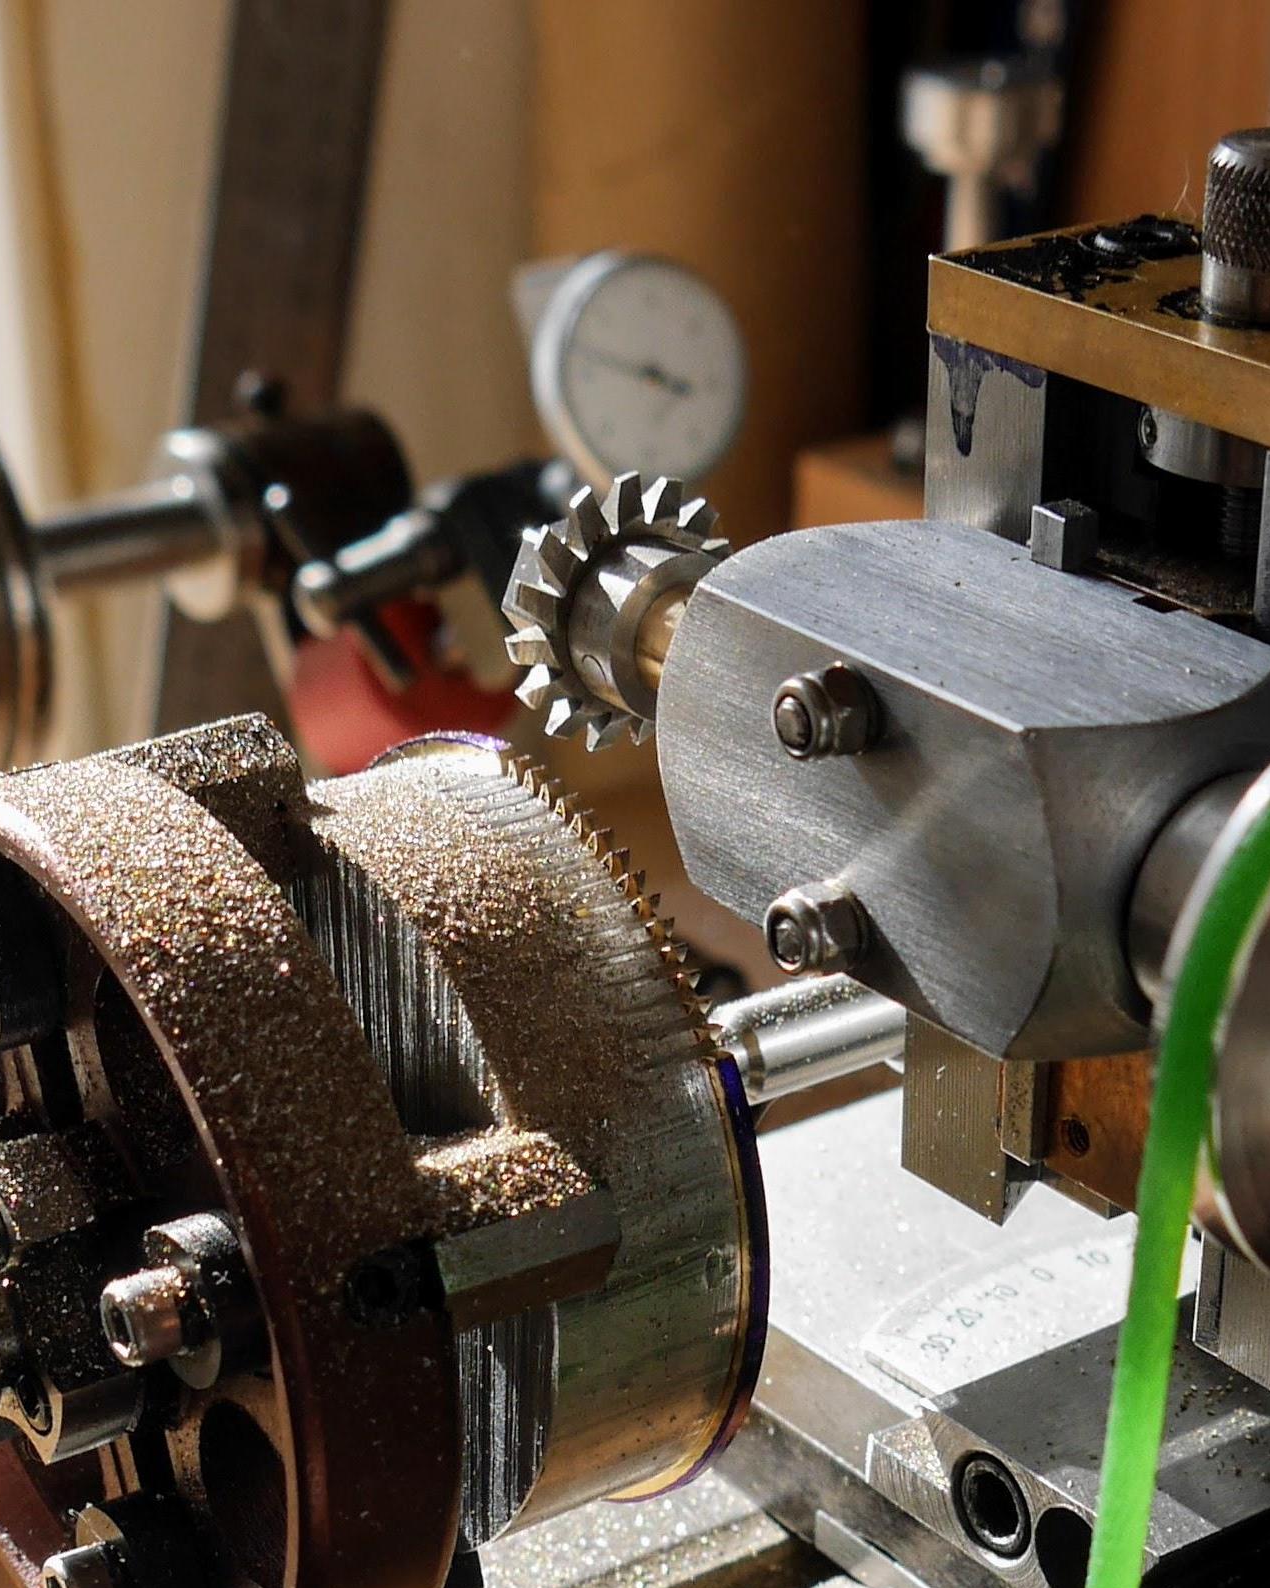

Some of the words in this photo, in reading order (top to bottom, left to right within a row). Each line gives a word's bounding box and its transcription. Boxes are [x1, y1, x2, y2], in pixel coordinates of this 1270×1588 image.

[945, 1306, 985, 1329] 20
[1030, 1268, 1054, 1280] 0
[1076, 1250, 1110, 1267] 10
